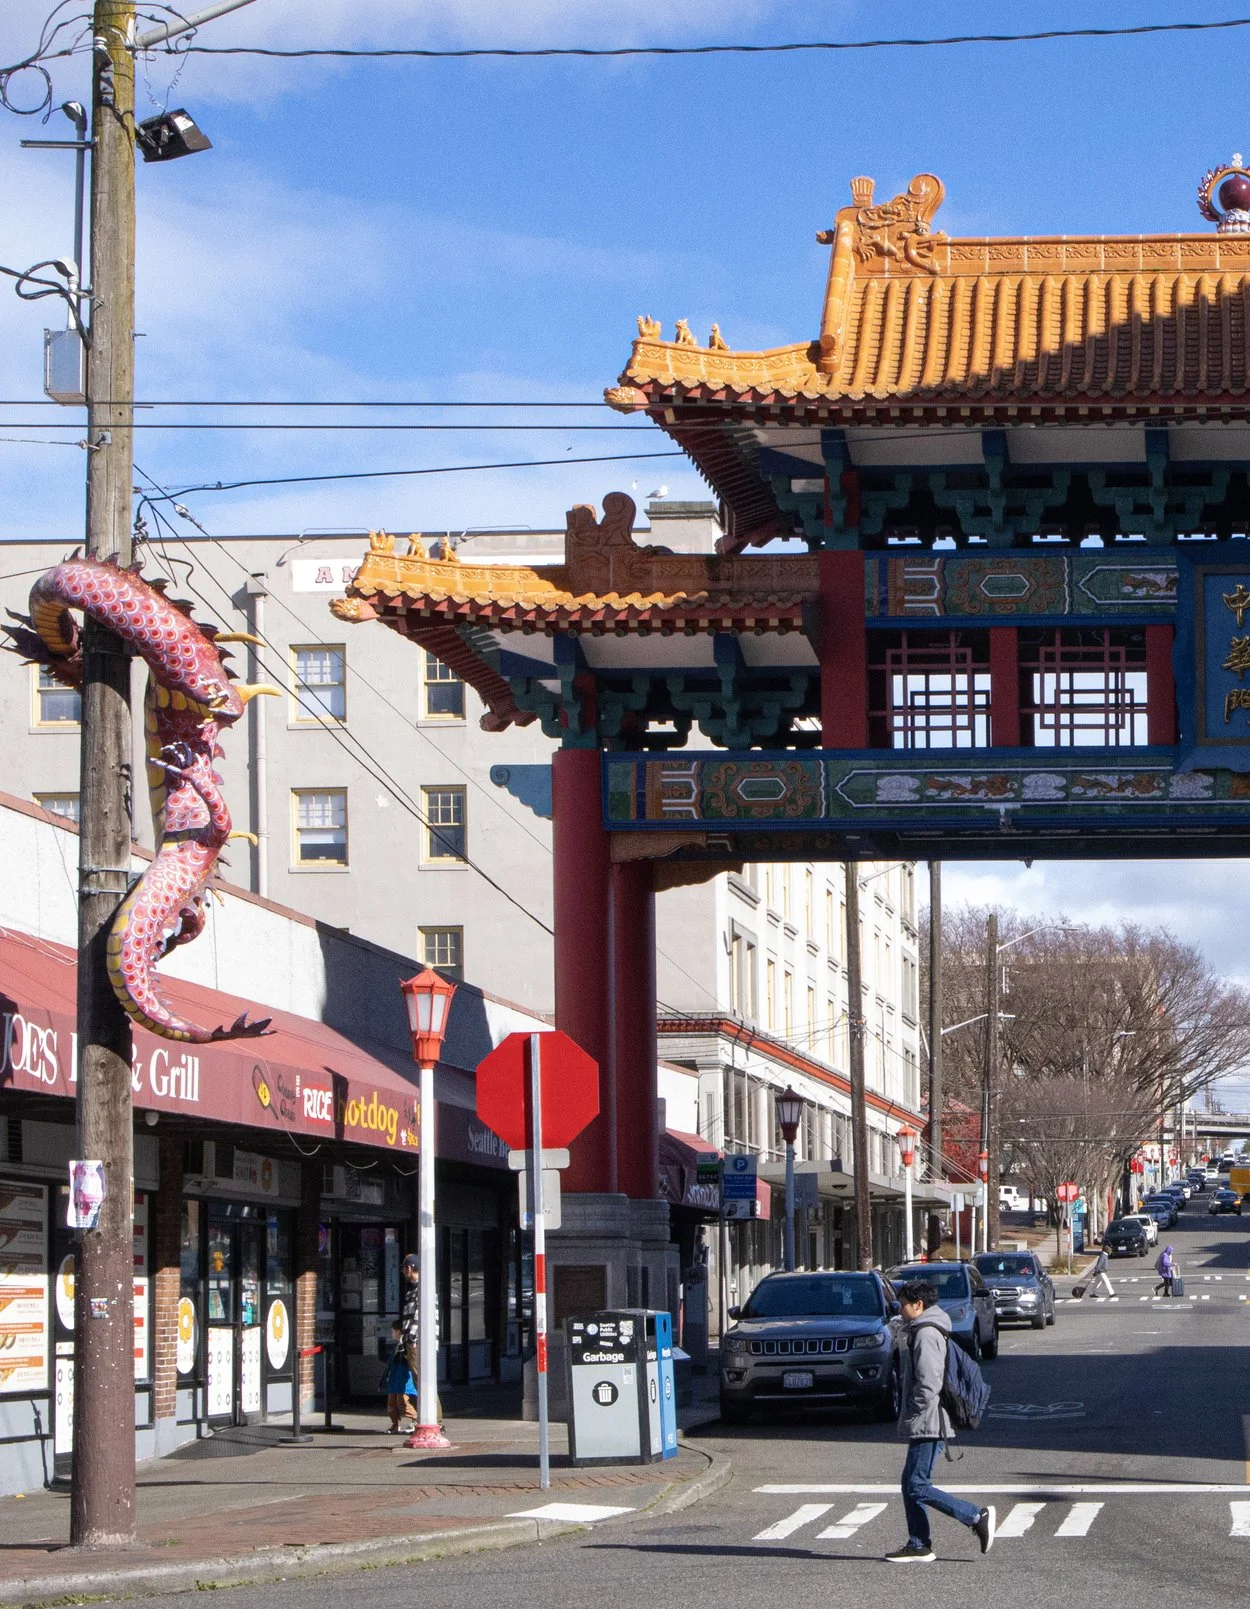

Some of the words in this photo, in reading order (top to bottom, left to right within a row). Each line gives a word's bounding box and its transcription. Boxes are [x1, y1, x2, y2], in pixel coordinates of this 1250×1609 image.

[150, 1048, 200, 1102] Grill
[302, 1087, 333, 1121] RICE
[336, 1088, 399, 1146] hotdog
[467, 1124, 498, 1156] Seattle
[583, 1350, 625, 1363] Garbage
